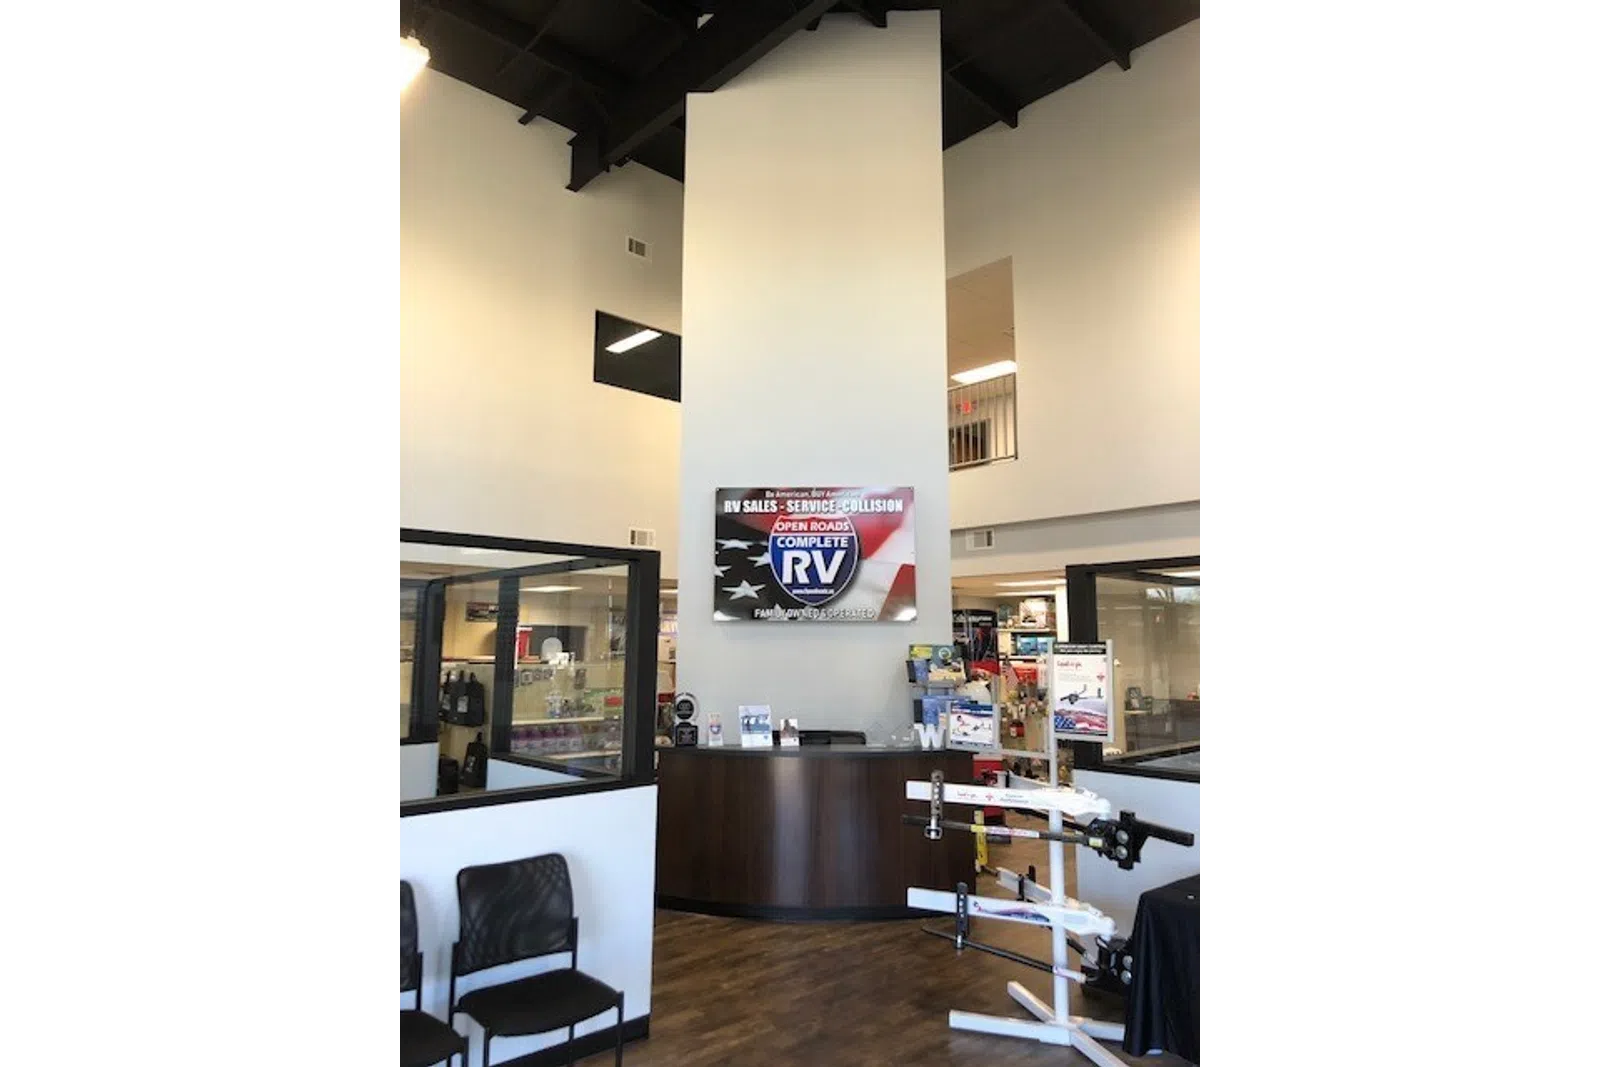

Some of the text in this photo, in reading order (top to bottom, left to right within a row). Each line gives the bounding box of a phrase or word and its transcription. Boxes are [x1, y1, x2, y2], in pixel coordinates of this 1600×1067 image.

[723, 500, 741, 513] RV
[742, 500, 778, 513] SALES
[786, 500, 836, 513] SERVICE
[776, 521, 849, 532] OPEN ROADS
[776, 536, 849, 548] COMPLETE
[782, 550, 847, 584] RV
